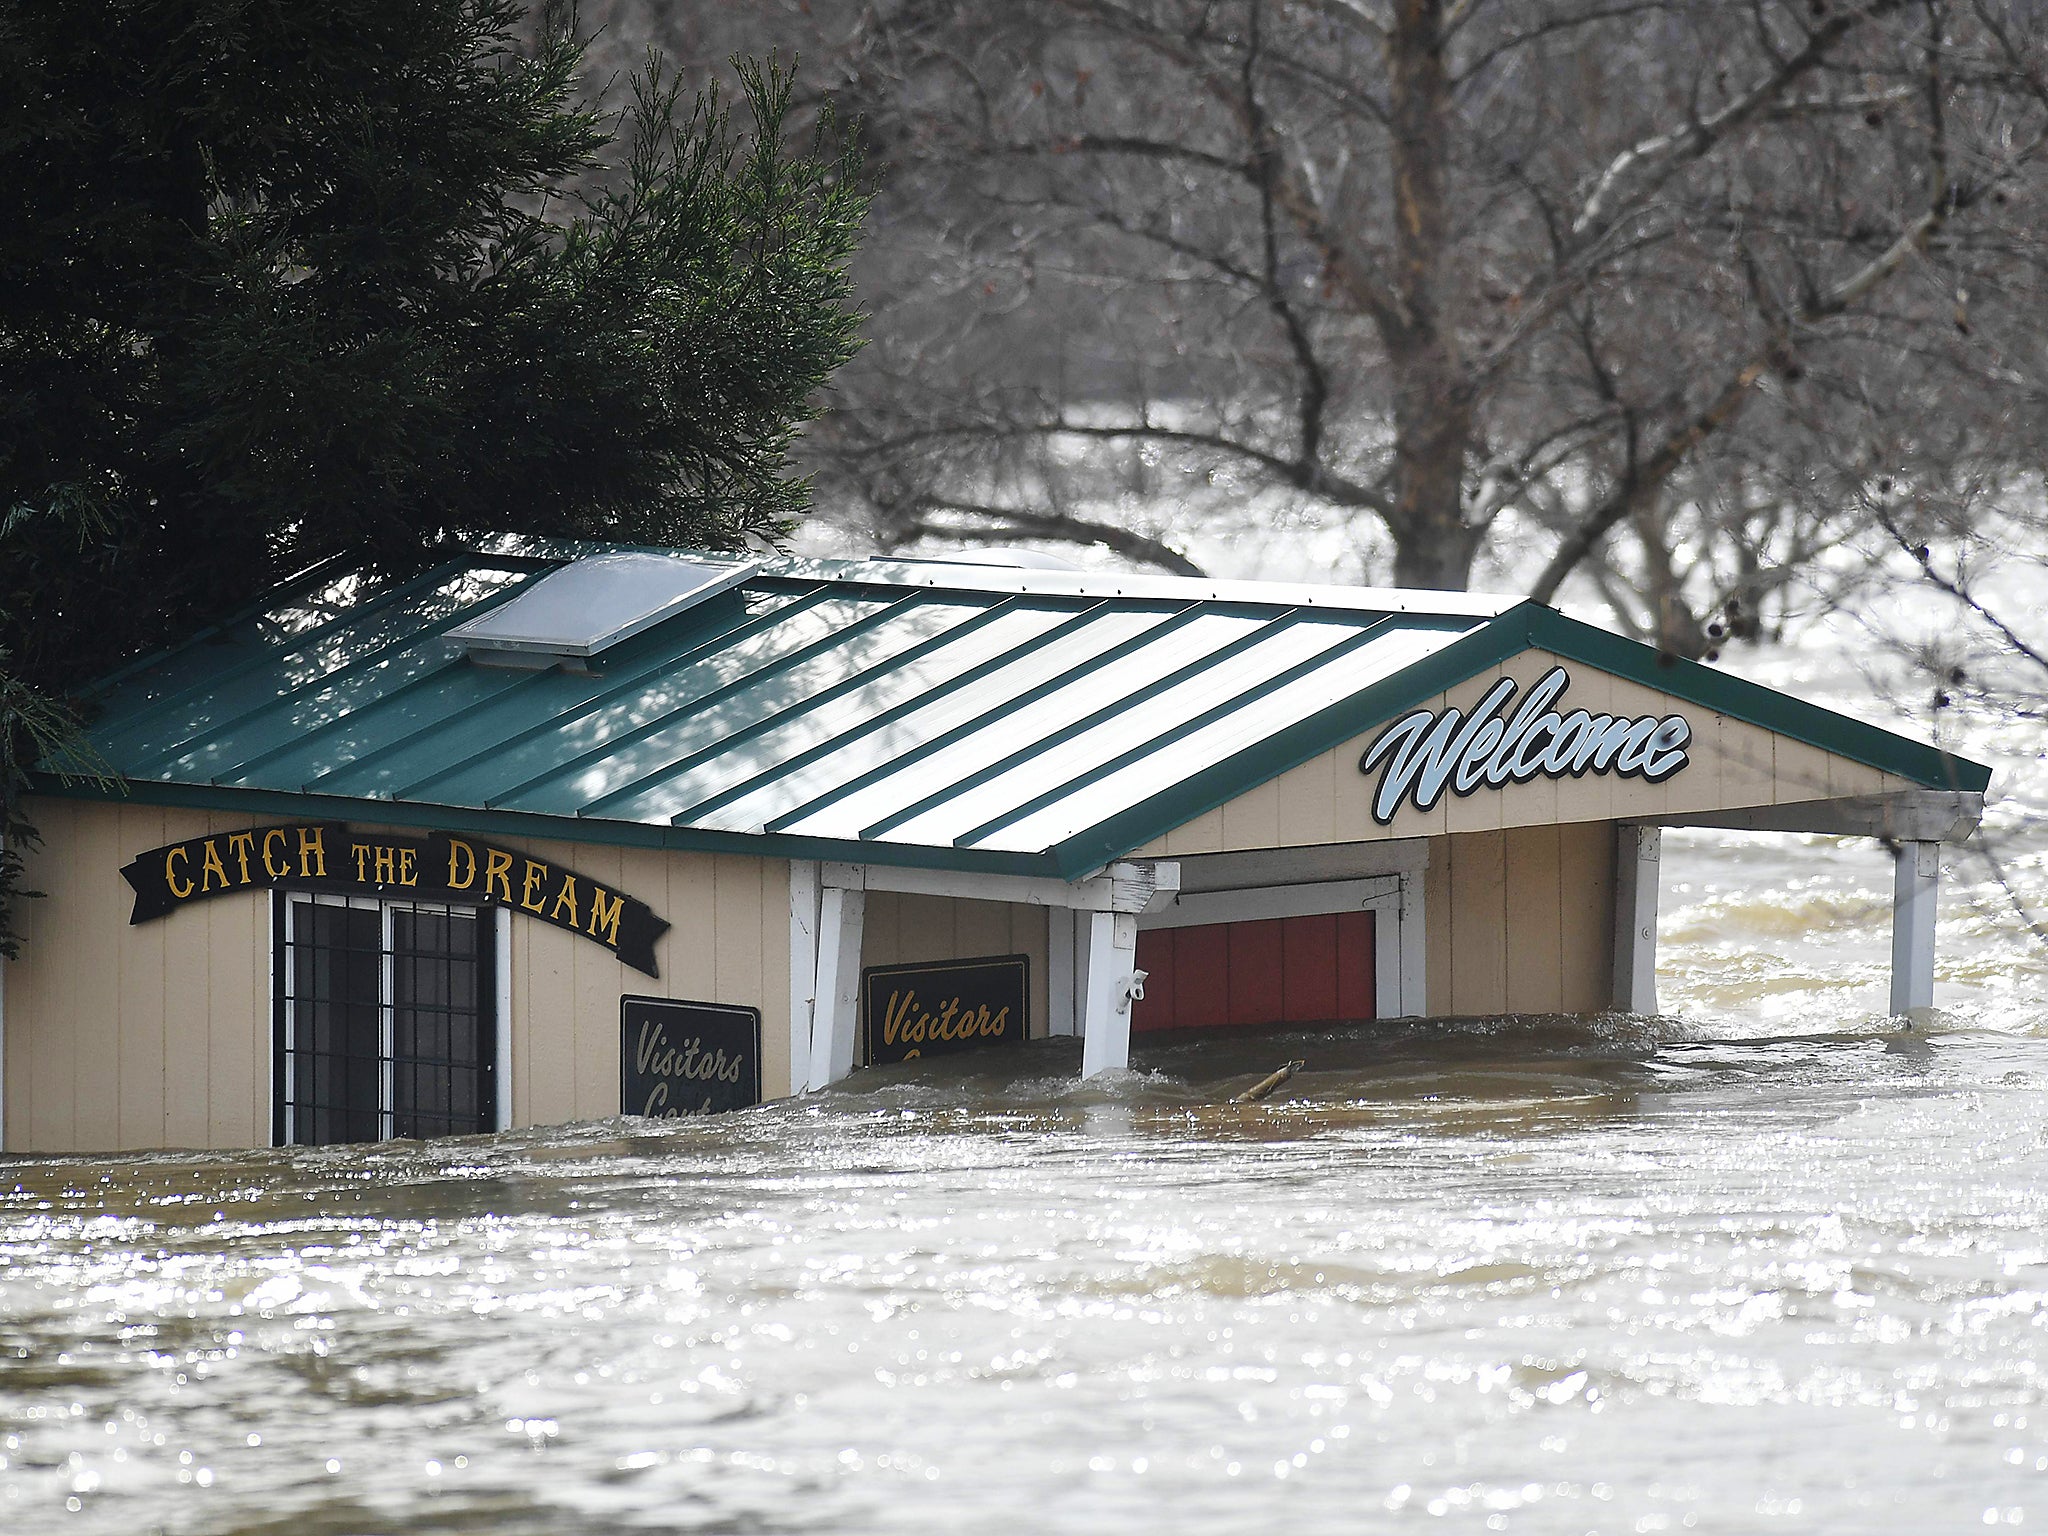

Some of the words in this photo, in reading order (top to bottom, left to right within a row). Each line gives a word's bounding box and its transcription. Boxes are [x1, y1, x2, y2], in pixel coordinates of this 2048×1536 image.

[1361, 666, 1691, 823] Welcome
[165, 827, 327, 898] CATCH
[351, 844, 418, 887] THE
[446, 839, 625, 947] DREAM
[636, 1020, 743, 1083] Visitors
[884, 990, 1010, 1046] Visitors
